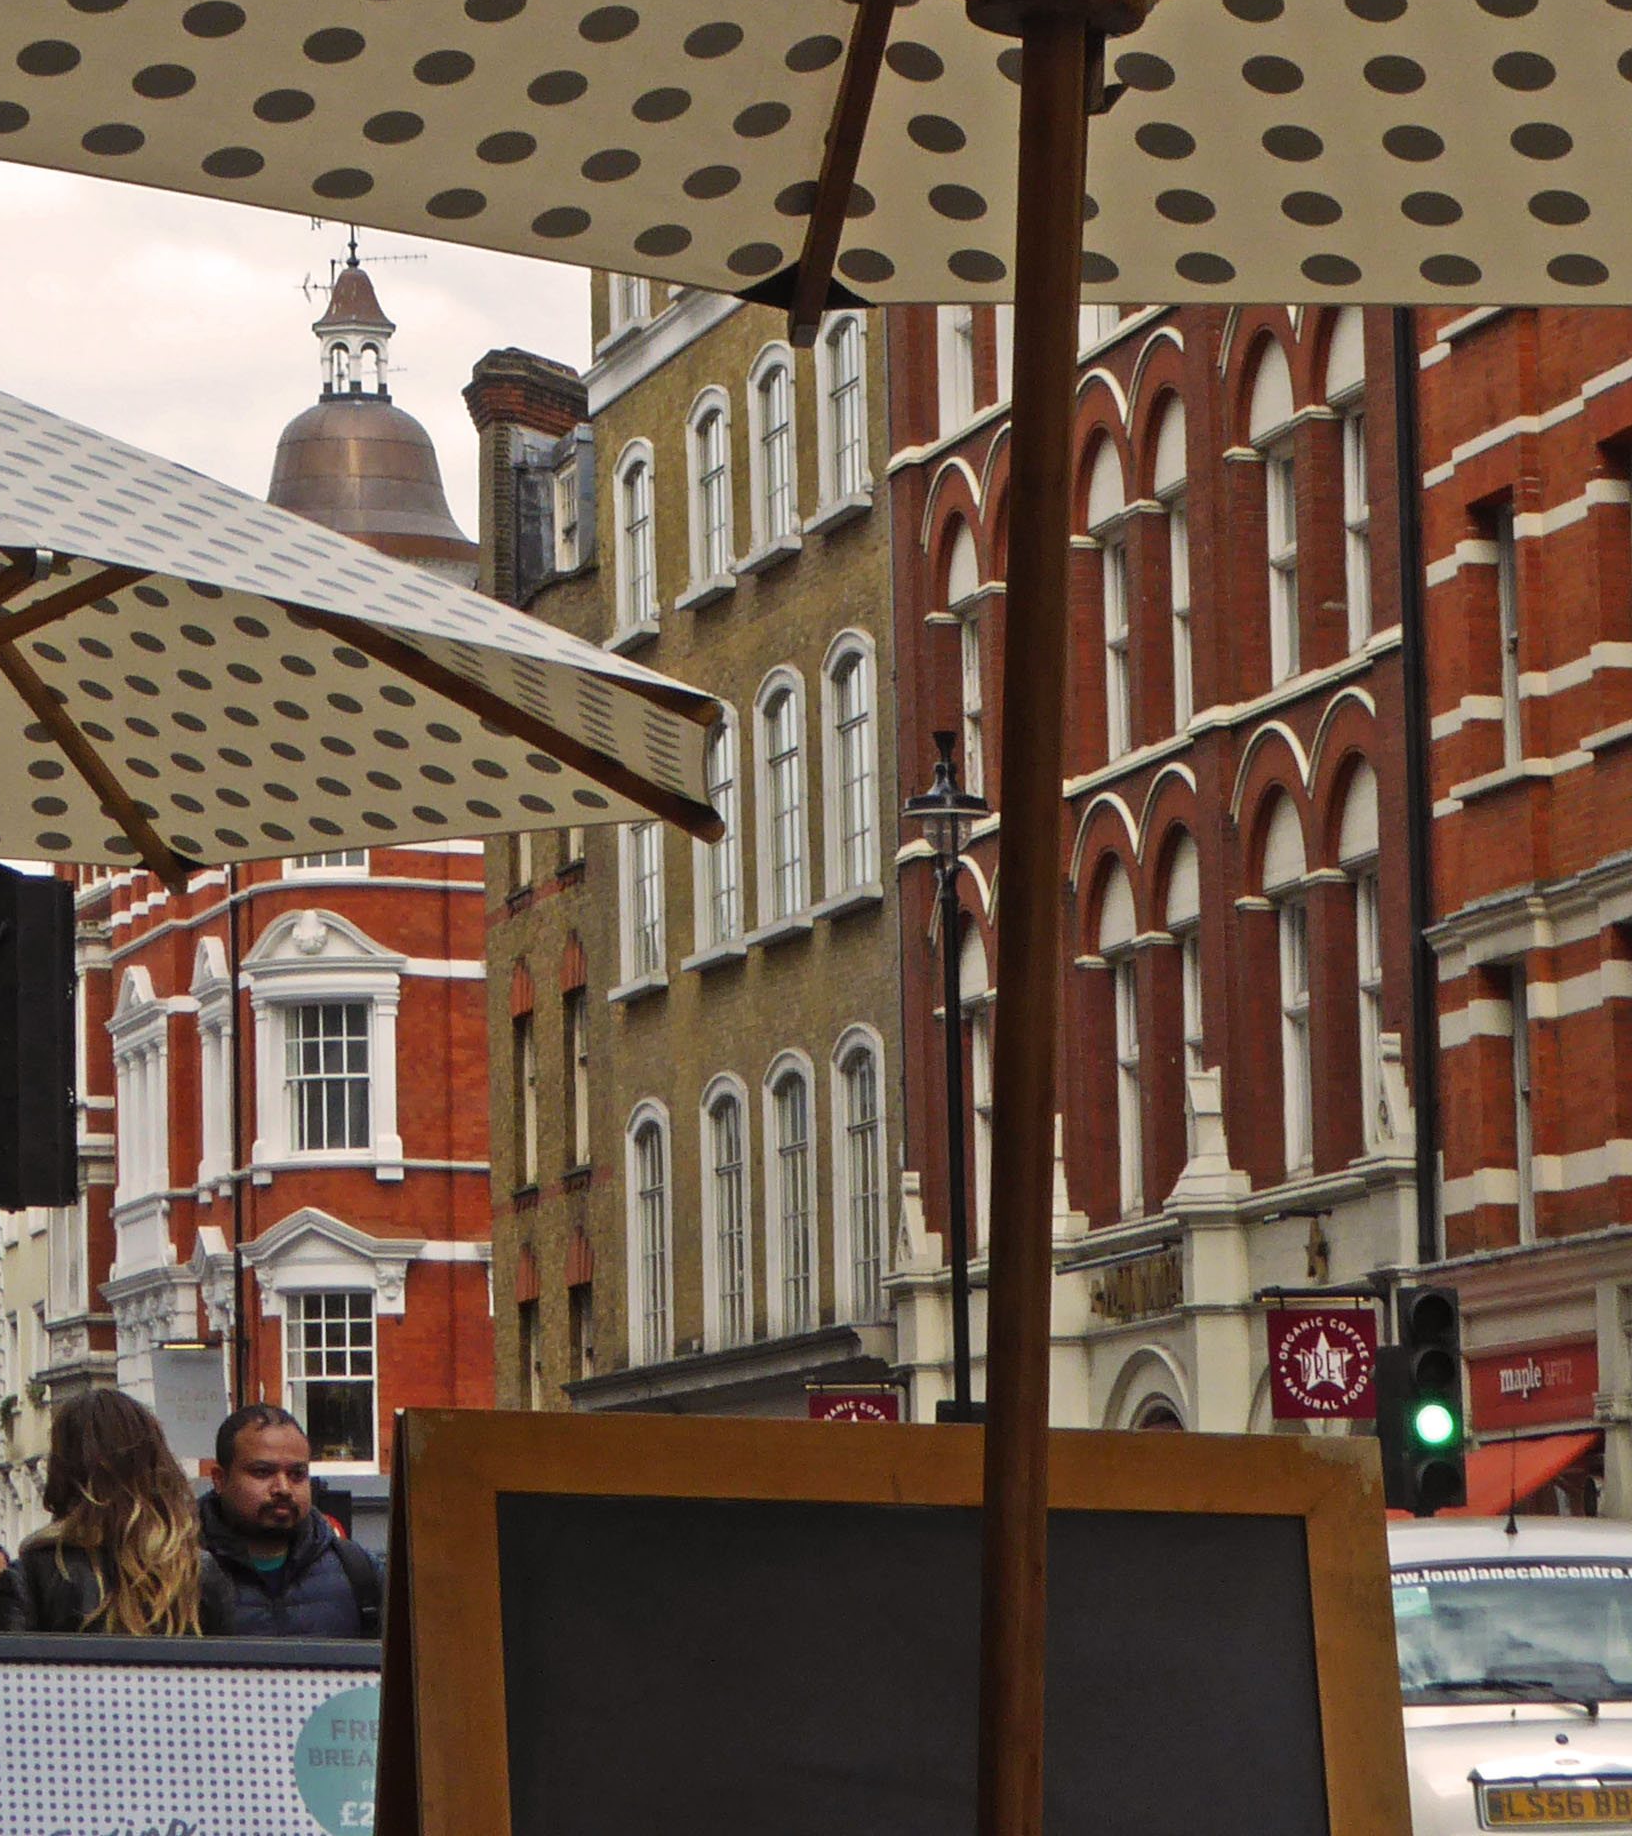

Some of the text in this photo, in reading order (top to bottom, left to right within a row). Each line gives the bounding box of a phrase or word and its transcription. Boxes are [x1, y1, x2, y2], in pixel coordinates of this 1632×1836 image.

[1278, 1316, 1370, 1361] ORGANIC COFFEE
[1299, 1347, 1349, 1383] PRET
[1499, 1357, 1543, 1399] maple
[1283, 1375, 1369, 1411] NATURAL FOOD
[824, 1400, 887, 1421] GANIC COFF
[331, 1719, 379, 1741] FRE
[309, 1747, 376, 1767] BREA
[1507, 1789, 1585, 1818] LS56
